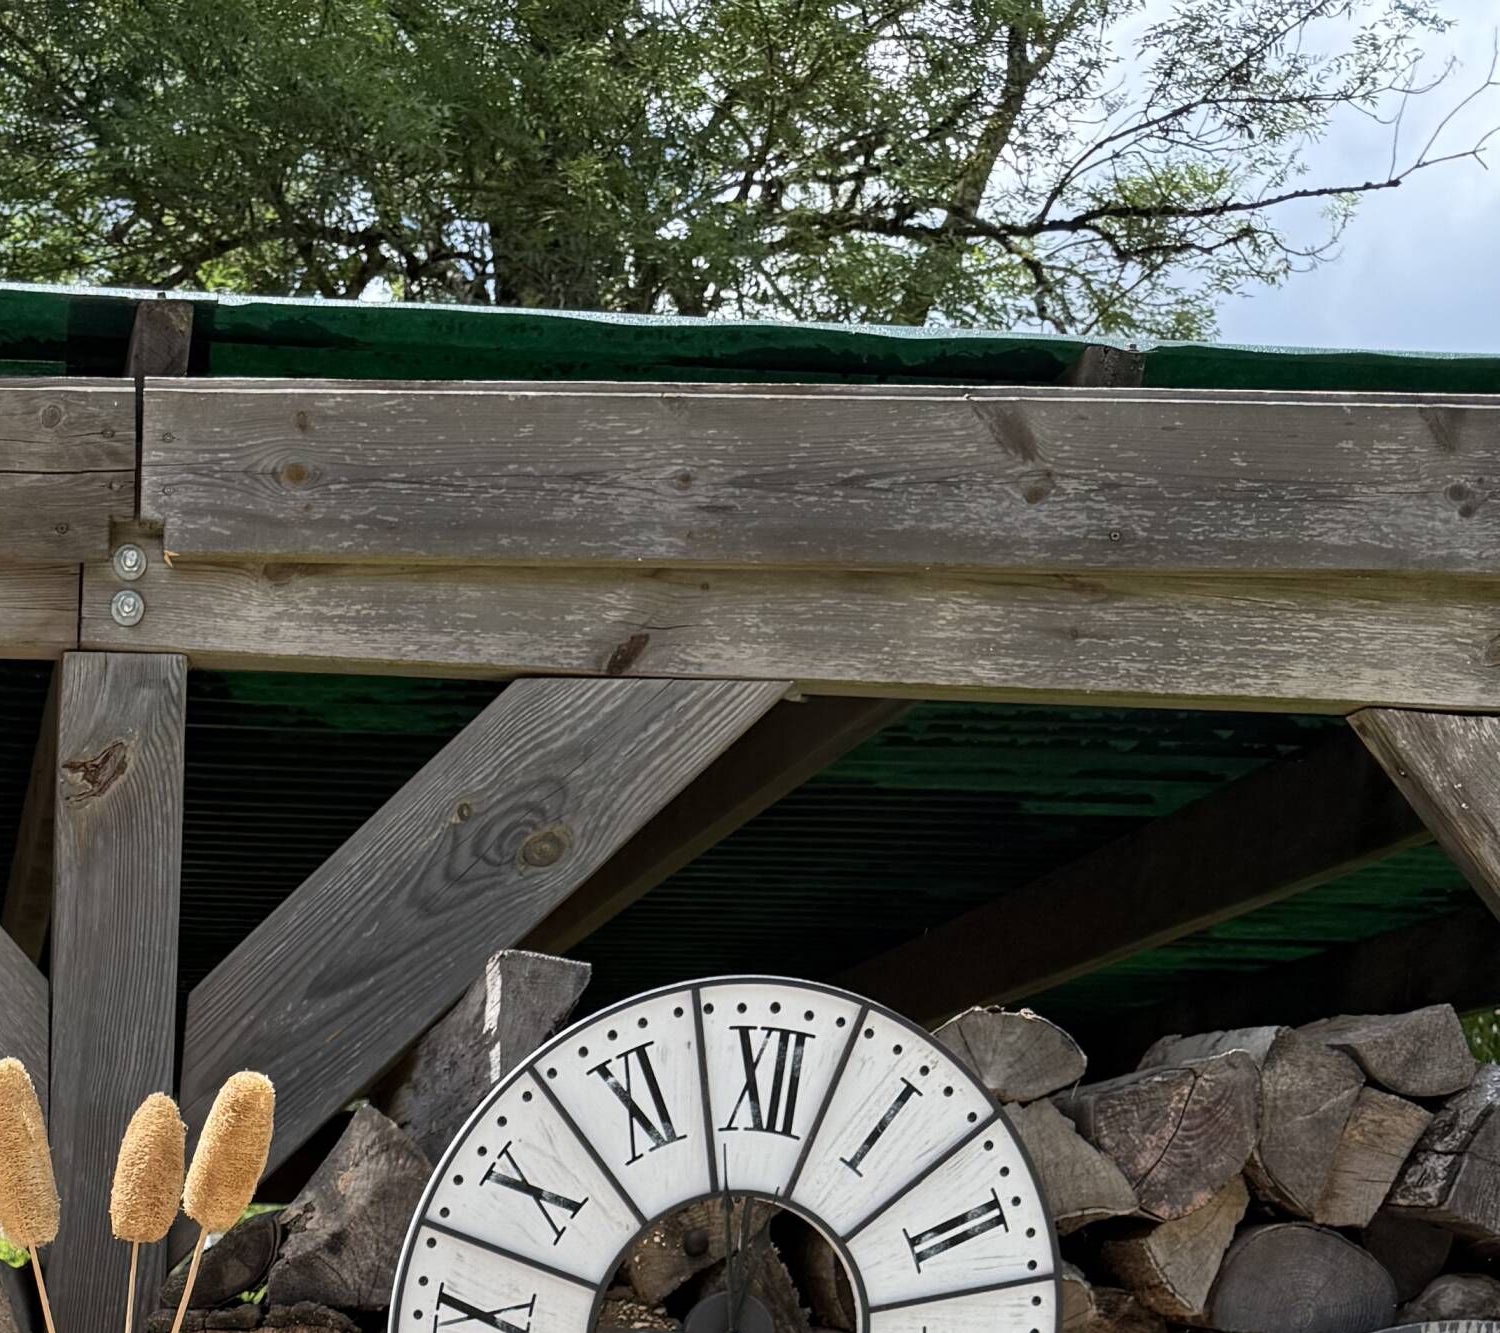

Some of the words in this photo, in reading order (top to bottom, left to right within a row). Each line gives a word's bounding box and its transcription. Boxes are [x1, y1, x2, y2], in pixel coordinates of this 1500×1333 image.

[587, 1041, 687, 1165] XI
[718, 1026, 816, 1141] XII
[839, 1077, 923, 1177] I
[479, 1141, 589, 1246] X
[903, 1187, 1009, 1273] II
